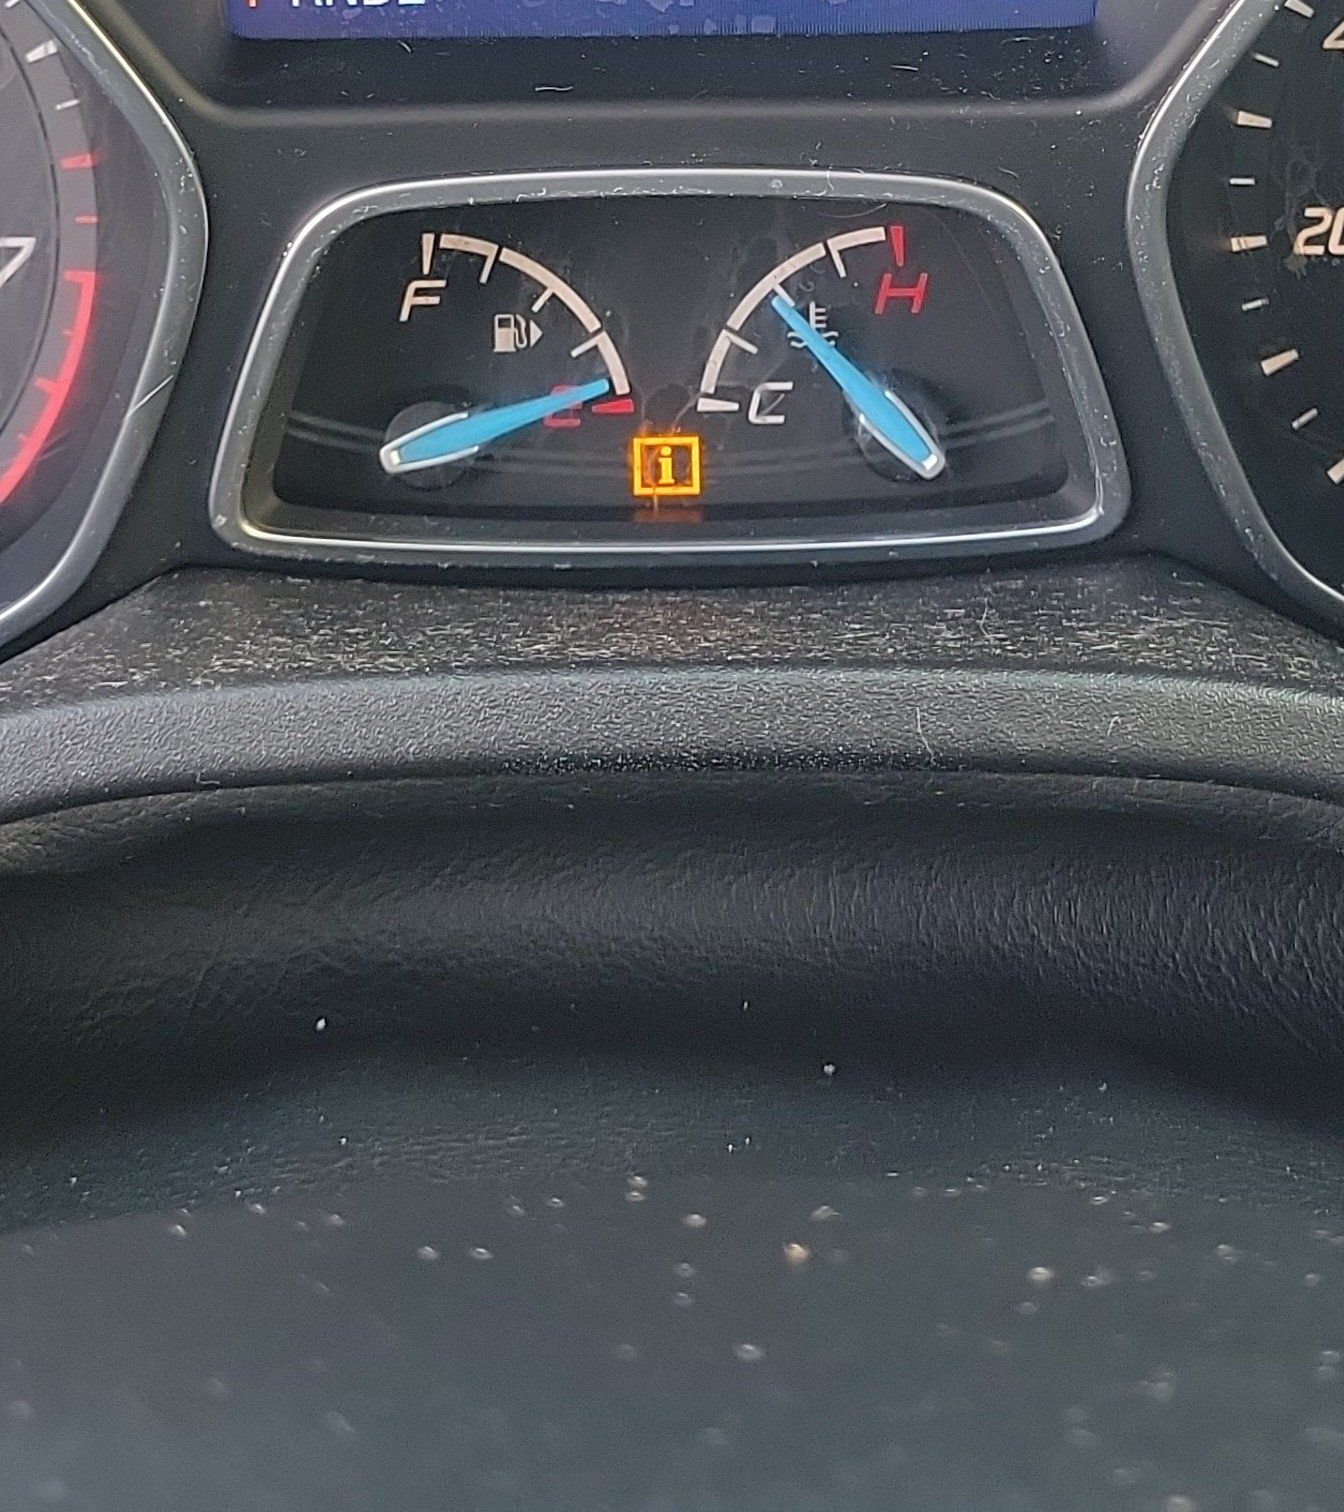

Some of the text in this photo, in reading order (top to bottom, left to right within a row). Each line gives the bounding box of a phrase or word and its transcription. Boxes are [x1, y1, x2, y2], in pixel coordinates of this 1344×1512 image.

[400, 280, 446, 321] F
[876, 273, 927, 314] H
[749, 382, 793, 423] C
